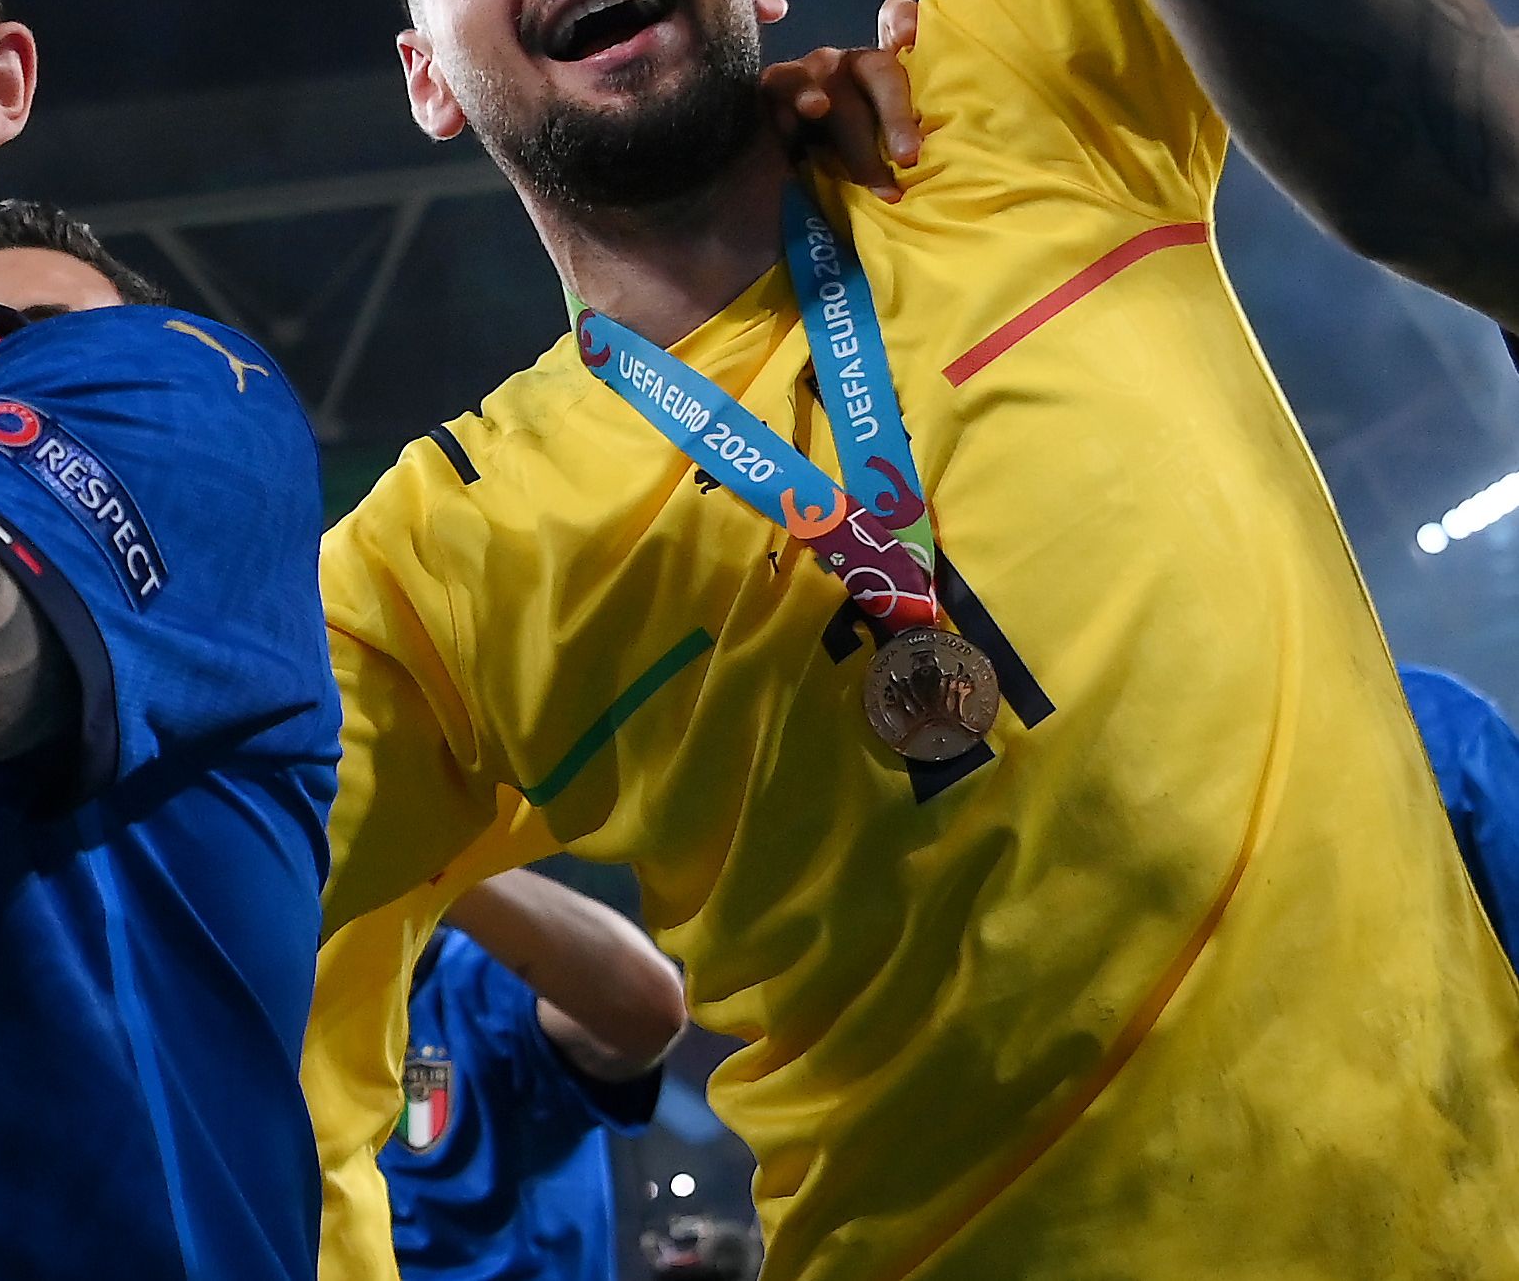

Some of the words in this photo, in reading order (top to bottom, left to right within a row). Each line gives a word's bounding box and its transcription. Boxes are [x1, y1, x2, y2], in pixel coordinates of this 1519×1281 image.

[804, 217, 841, 279] 2020
[818, 280, 860, 360] EURO
[618, 349, 665, 406] UEFA
[662, 384, 711, 434] EURO
[839, 356, 880, 444] UEFA
[35, 437, 162, 598] RESPECT
